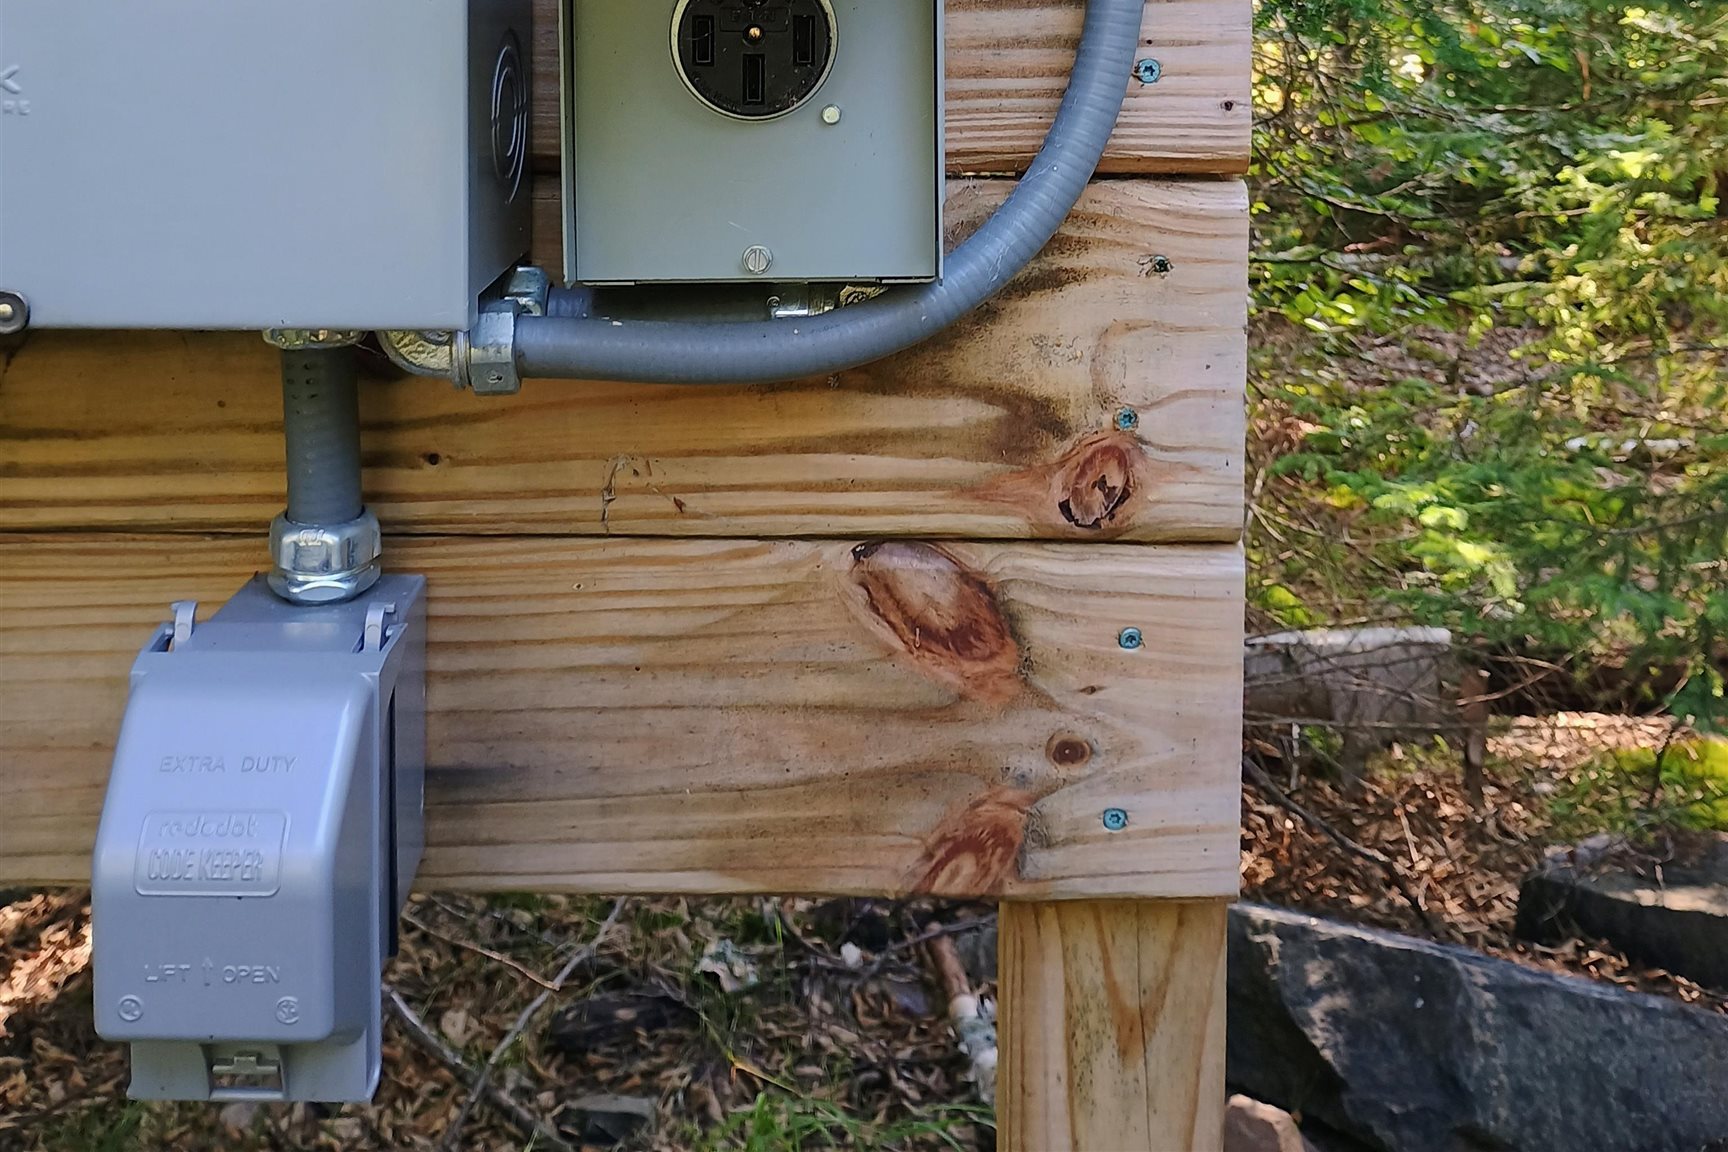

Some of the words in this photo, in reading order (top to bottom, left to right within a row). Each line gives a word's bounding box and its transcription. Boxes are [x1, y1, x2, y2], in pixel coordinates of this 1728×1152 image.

[159, 755, 226, 773] EXTRA
[241, 755, 298, 773] DUTY
[147, 849, 194, 881] CODE
[198, 849, 264, 882] KEEPER
[144, 963, 191, 984] LIFT
[222, 964, 281, 984] OPEN
